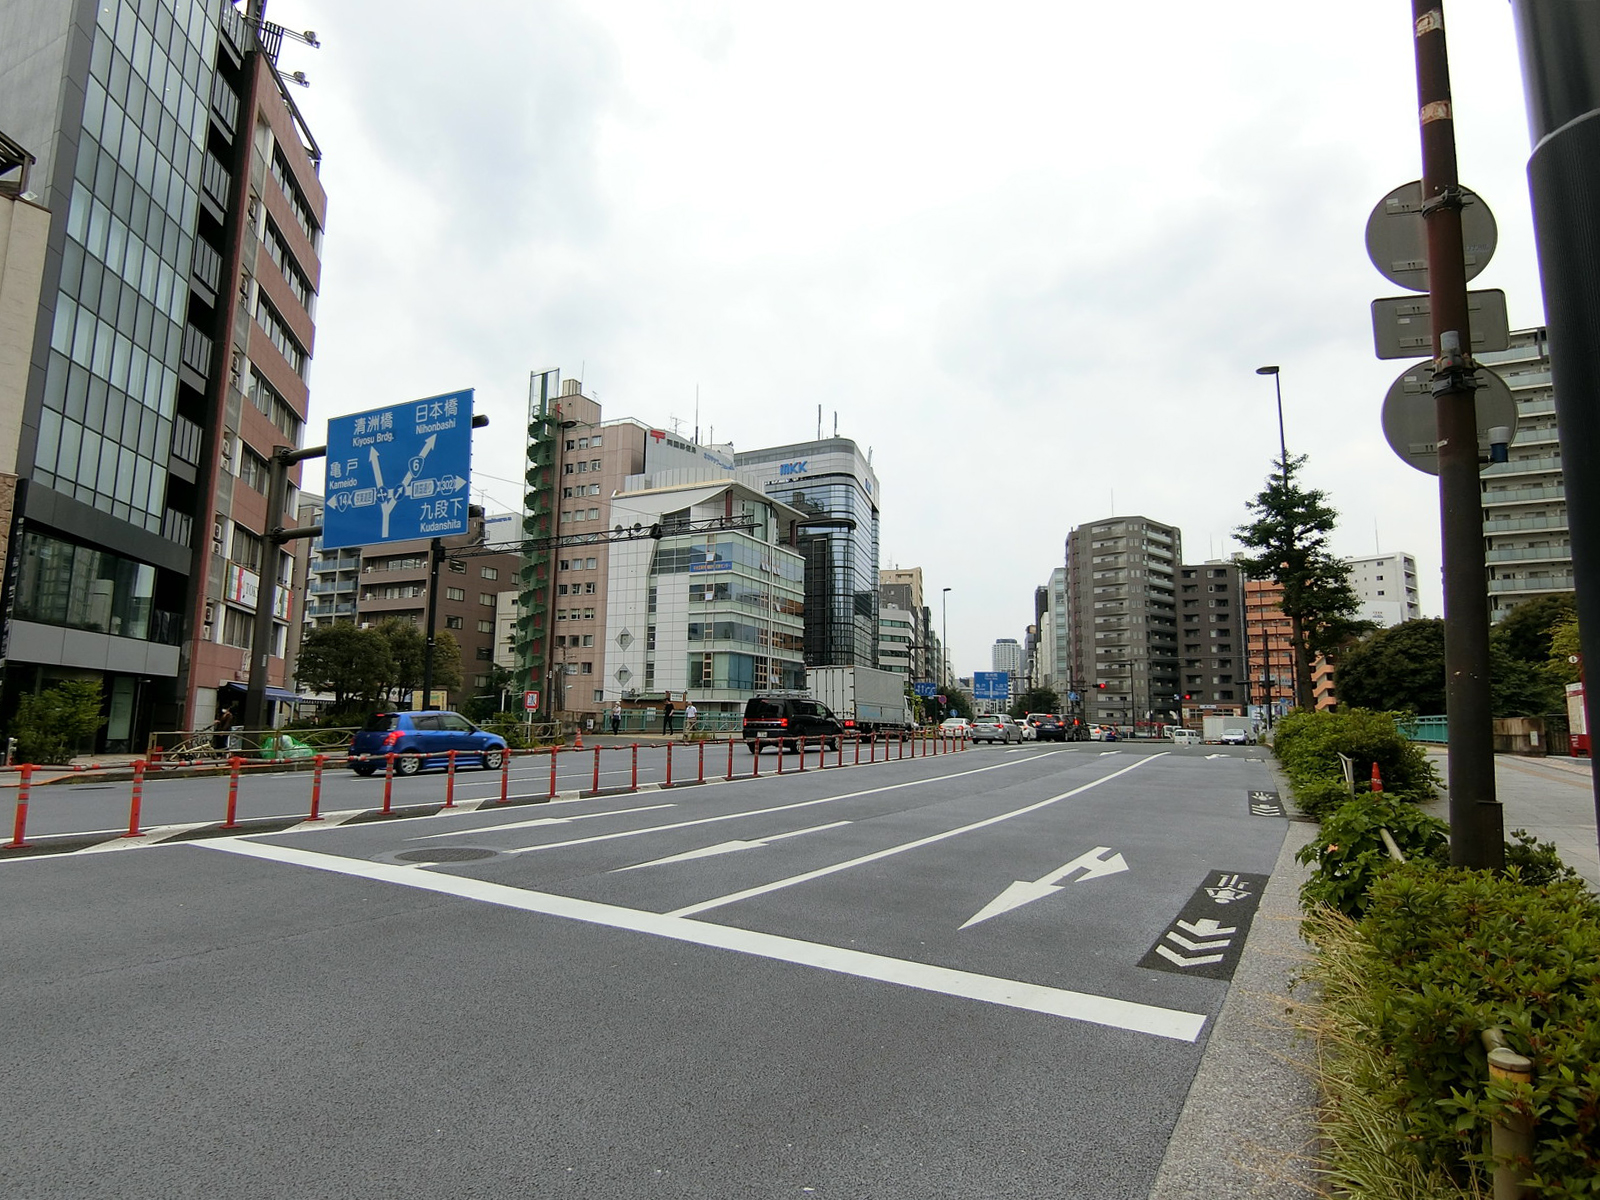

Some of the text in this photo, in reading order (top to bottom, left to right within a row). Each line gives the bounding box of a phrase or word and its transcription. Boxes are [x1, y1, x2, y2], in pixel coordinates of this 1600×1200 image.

[416, 398, 458, 422] 日本橋
[354, 412, 394, 434] 清洲橋
[416, 418, 456, 434] Nihonbashi
[352, 432, 395, 446] Kiyosu Brdg.
[330, 458, 358, 478] 亀戸
[413, 460, 419, 471] 6
[329, 479, 357, 490] Kameido
[441, 479, 453, 490] 302
[338, 496, 347, 506] 14
[420, 498, 464, 520] 九段下
[420, 519, 462, 532] Kudanshita
